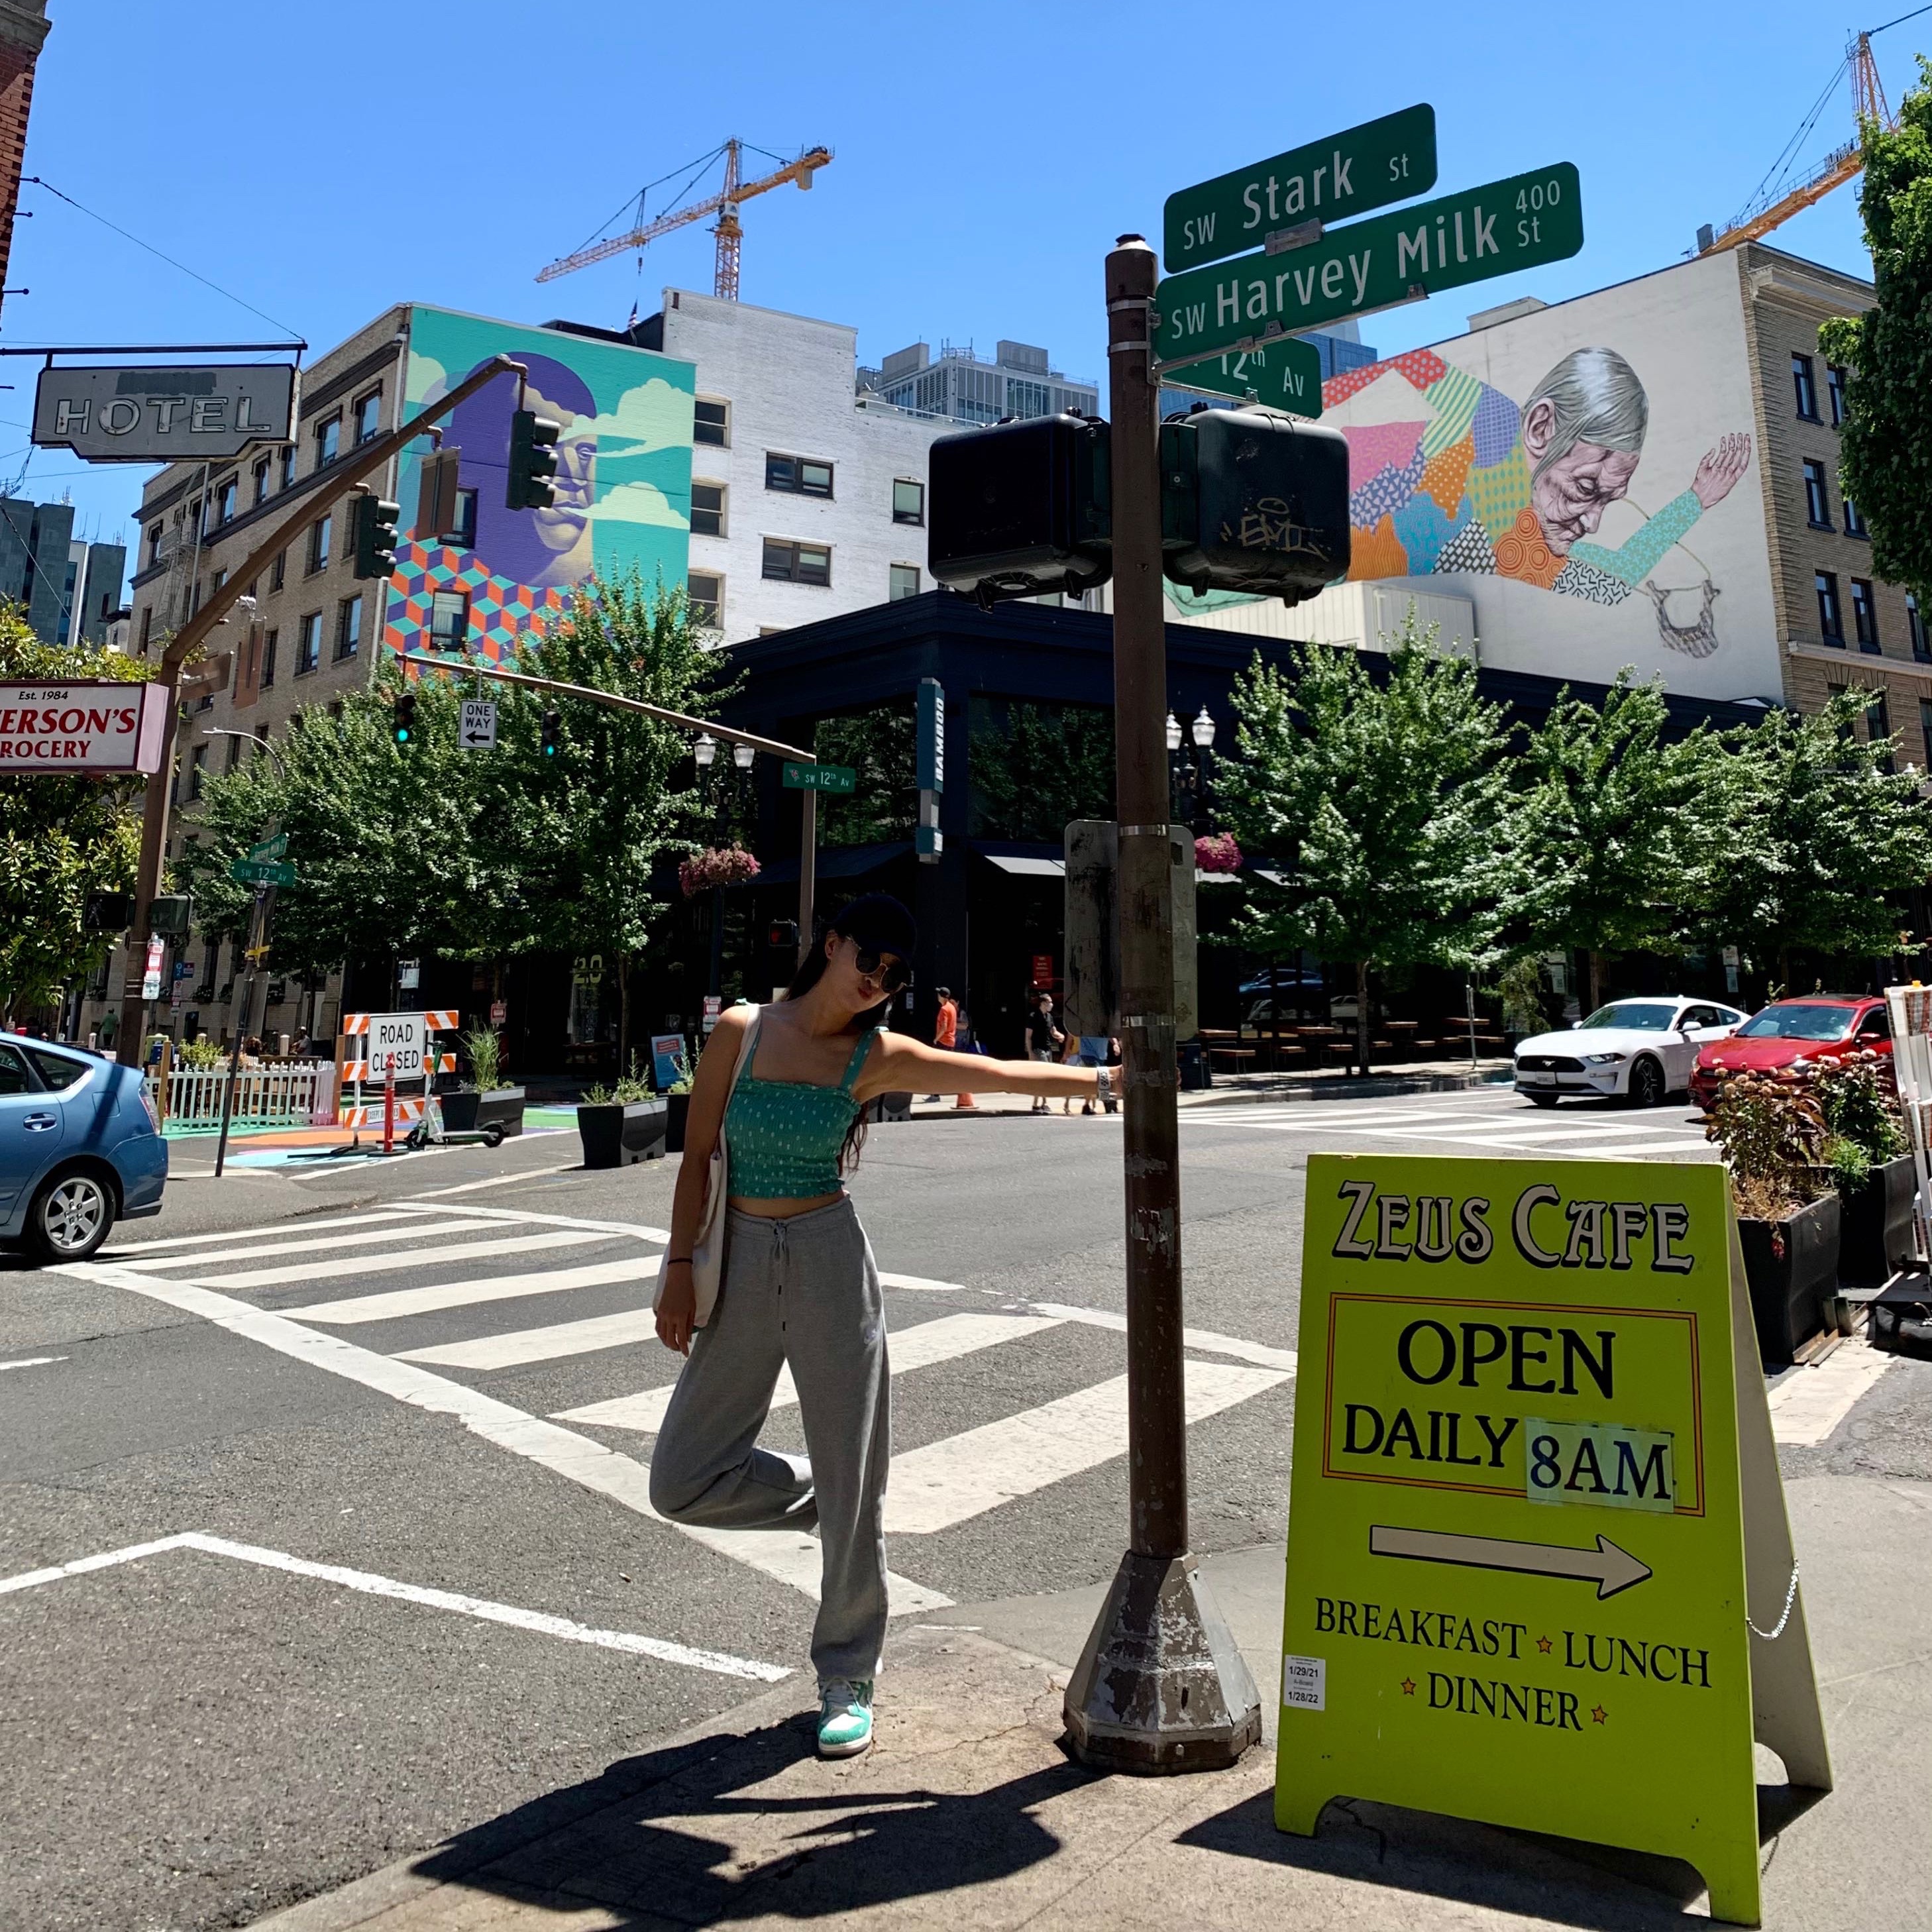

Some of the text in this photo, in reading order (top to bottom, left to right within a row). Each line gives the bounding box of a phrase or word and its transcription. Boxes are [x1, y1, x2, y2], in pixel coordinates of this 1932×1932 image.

[1183, 150, 1409, 250] SW Stark St
[1516, 180, 1560, 215] 400
[1171, 206, 1540, 340] SW Harvey Milk St
[1283, 366, 1303, 396] Av
[56, 397, 271, 435] HOTEL
[19, 691, 68, 700] Est. 1984
[467, 704, 490, 716] ONE
[0, 708, 136, 734] ERSON'S
[466, 717, 491, 728] WAY
[935, 698, 944, 781] BAMBOO
[805, 774, 816, 783] SW
[380, 1024, 413, 1044] ROAD
[372, 1050, 419, 1071] CLSED
[1331, 1180, 1694, 1275] ZEUS CAFE
[1397, 1320, 1616, 1399] OPEN
[1342, 1403, 1671, 1500] DAILY 8AM
[1315, 1597, 1712, 1688] BREAKFAST LUNCH
[1289, 1666, 1318, 1678] 1/29/21
[1288, 1691, 1318, 1703] 1/28/22
[1427, 1672, 1583, 1731] DINNER
